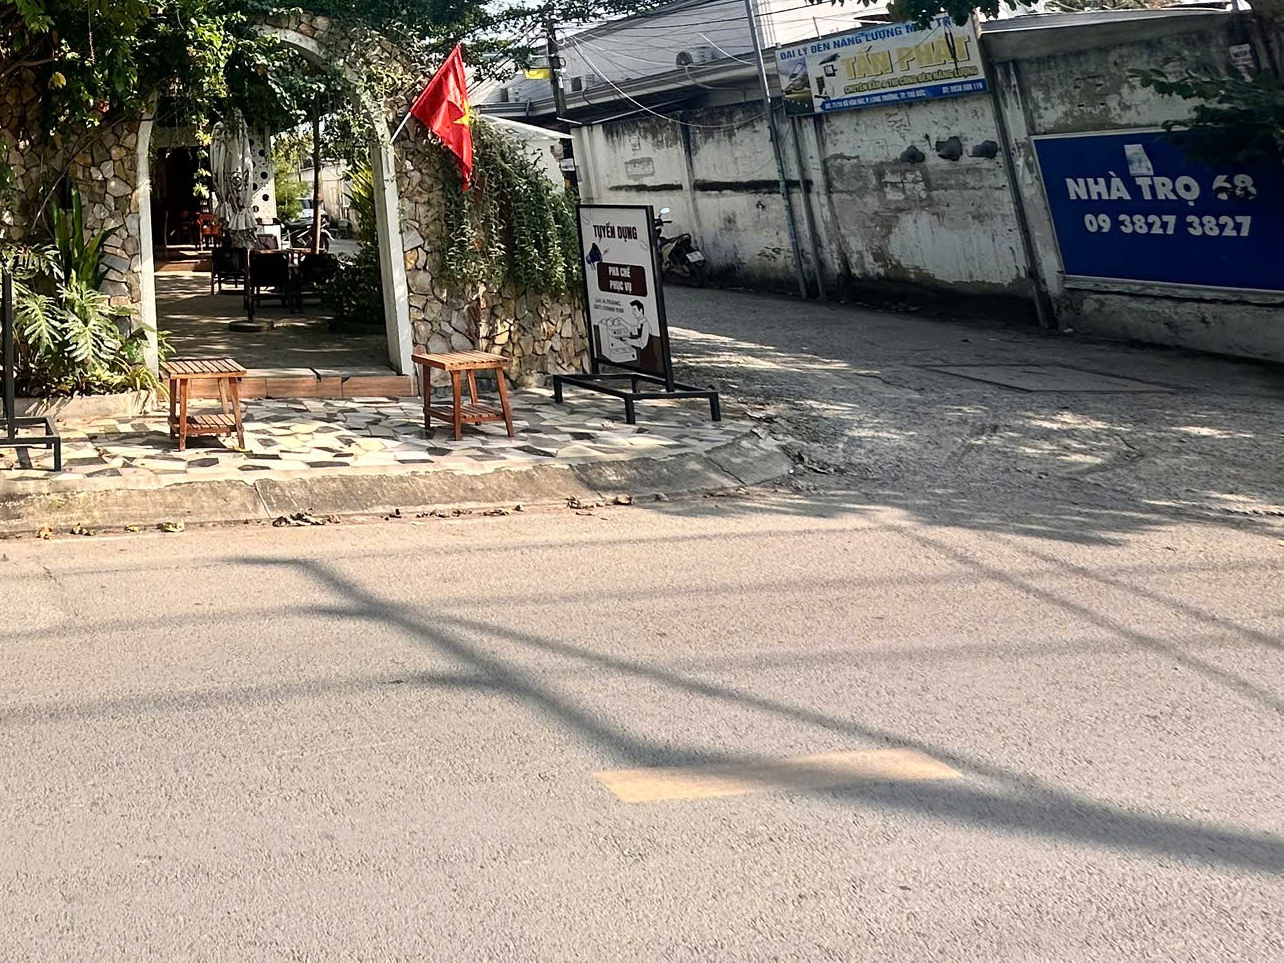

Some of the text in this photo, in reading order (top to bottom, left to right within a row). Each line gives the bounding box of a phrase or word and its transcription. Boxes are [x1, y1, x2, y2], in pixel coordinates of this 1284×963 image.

[1065, 171, 1257, 207] NHÀ TRỌ 68
[617, 225, 638, 243] DỤNG
[1084, 213, 1252, 237] 09 3827 3827
